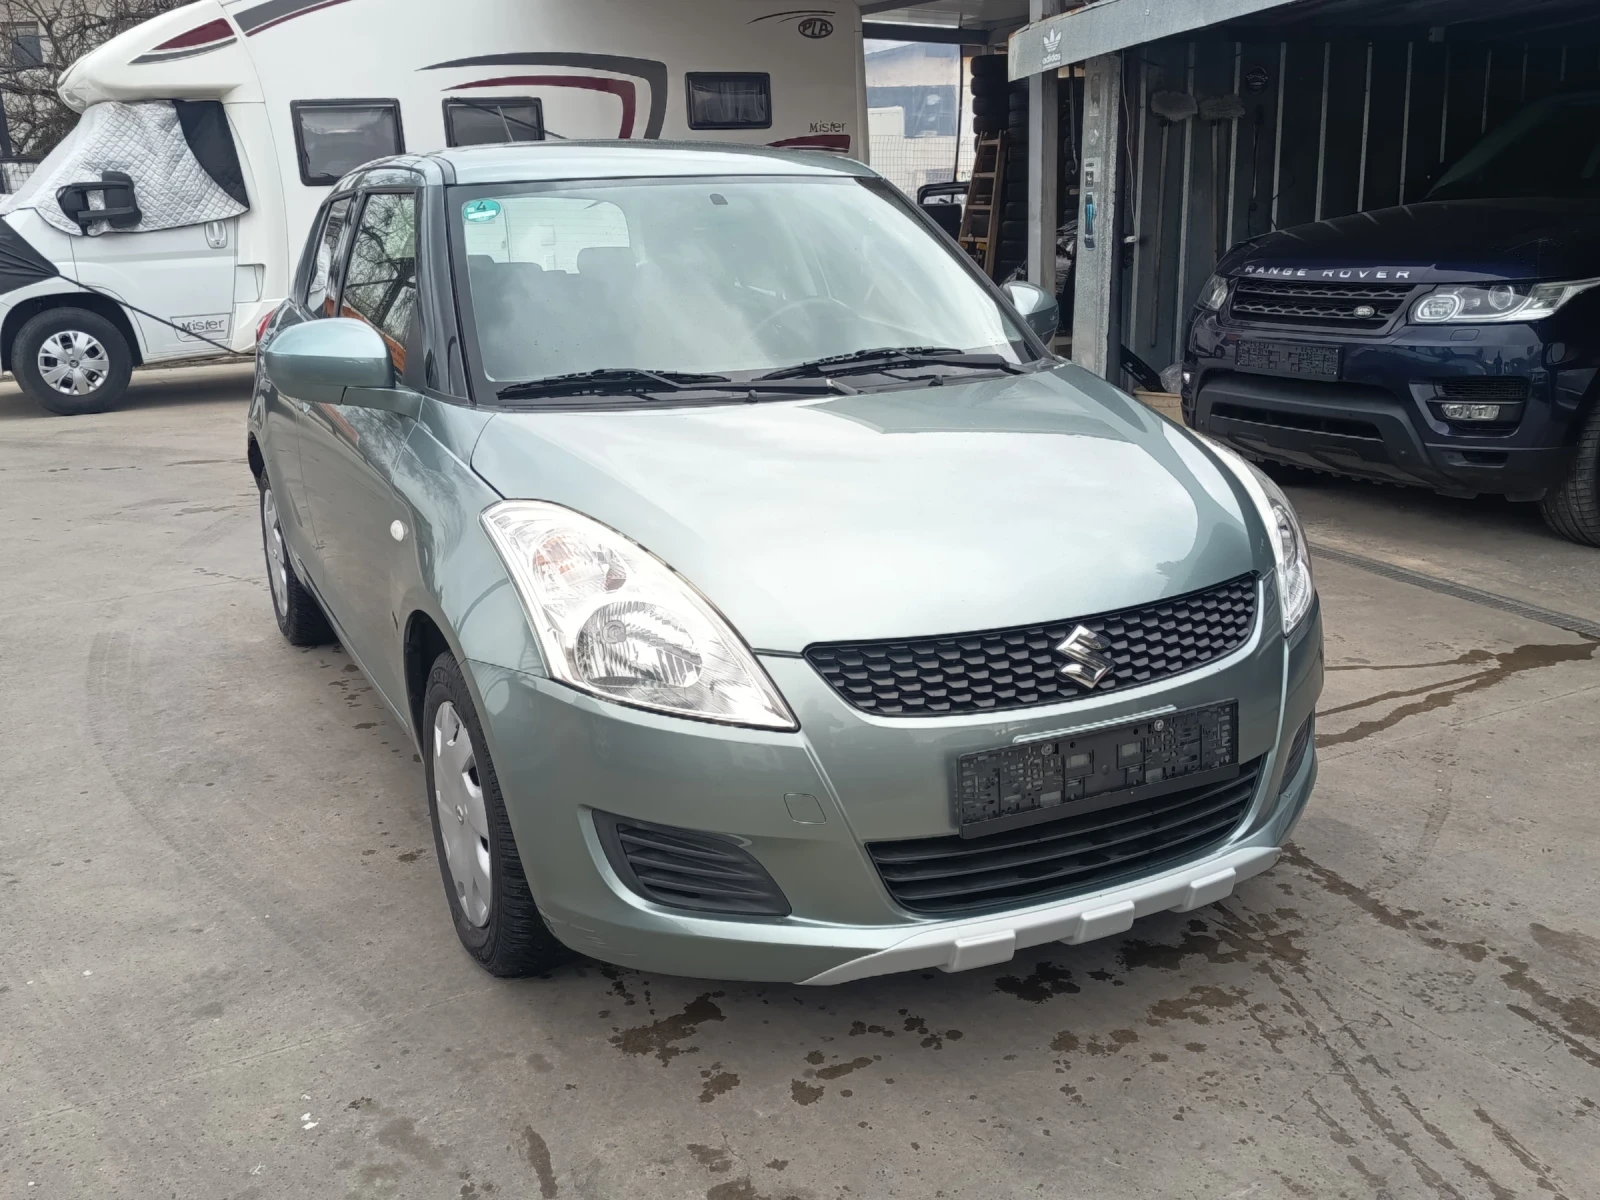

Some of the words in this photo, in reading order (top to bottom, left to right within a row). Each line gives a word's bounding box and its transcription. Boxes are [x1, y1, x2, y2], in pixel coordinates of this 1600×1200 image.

[800, 20, 831, 36] PLA
[808, 120, 847, 133] Mister
[476, 201, 487, 211] 4
[1244, 265, 1309, 277] RANGE
[1322, 269, 1411, 279] ROVER
[180, 319, 225, 332] Mister
